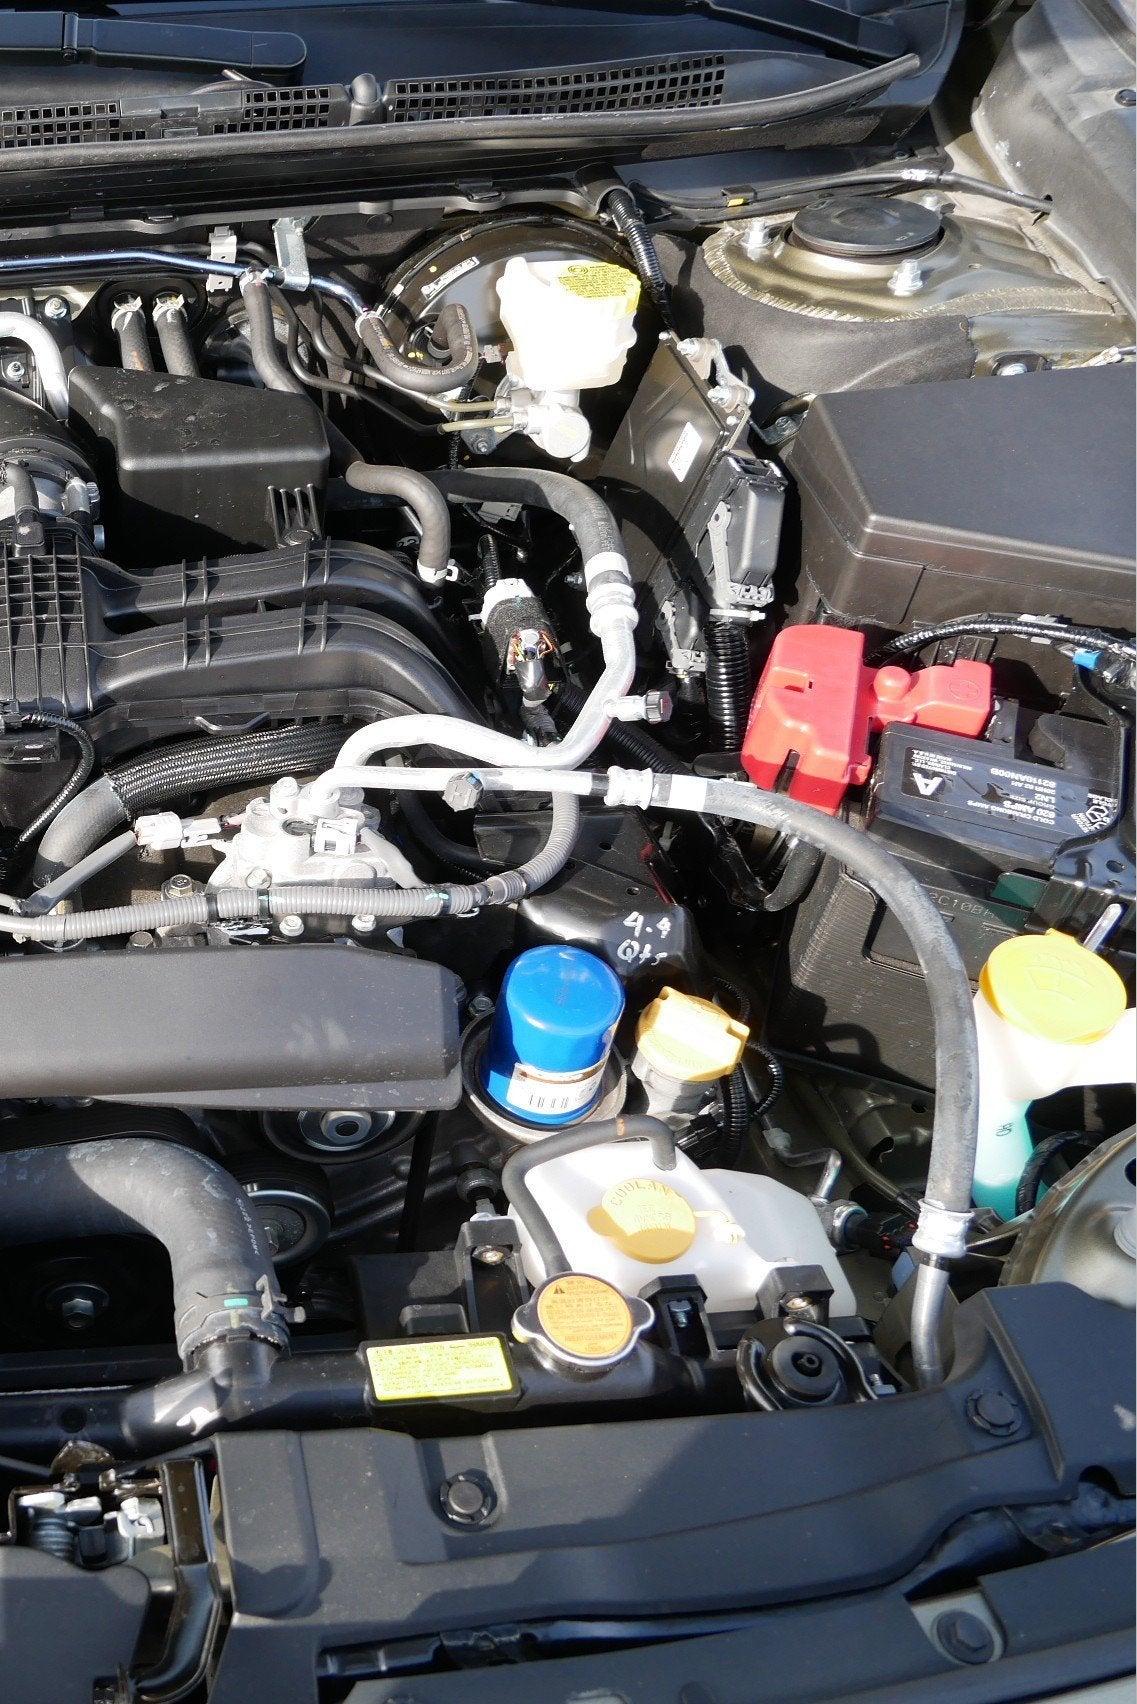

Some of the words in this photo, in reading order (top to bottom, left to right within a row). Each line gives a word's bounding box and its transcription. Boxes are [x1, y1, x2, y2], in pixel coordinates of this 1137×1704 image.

[913, 772, 944, 796] A
[1035, 794, 1056, 803] LN2
[967, 800, 990, 809] AMPS
[1003, 801, 1036, 814] AMPS
[991, 806, 1030, 819] CRANKING
[1037, 808, 1056, 818] 620
[1031, 815, 1055, 825] COLD
[610, 1181, 675, 1206] COOLAN
